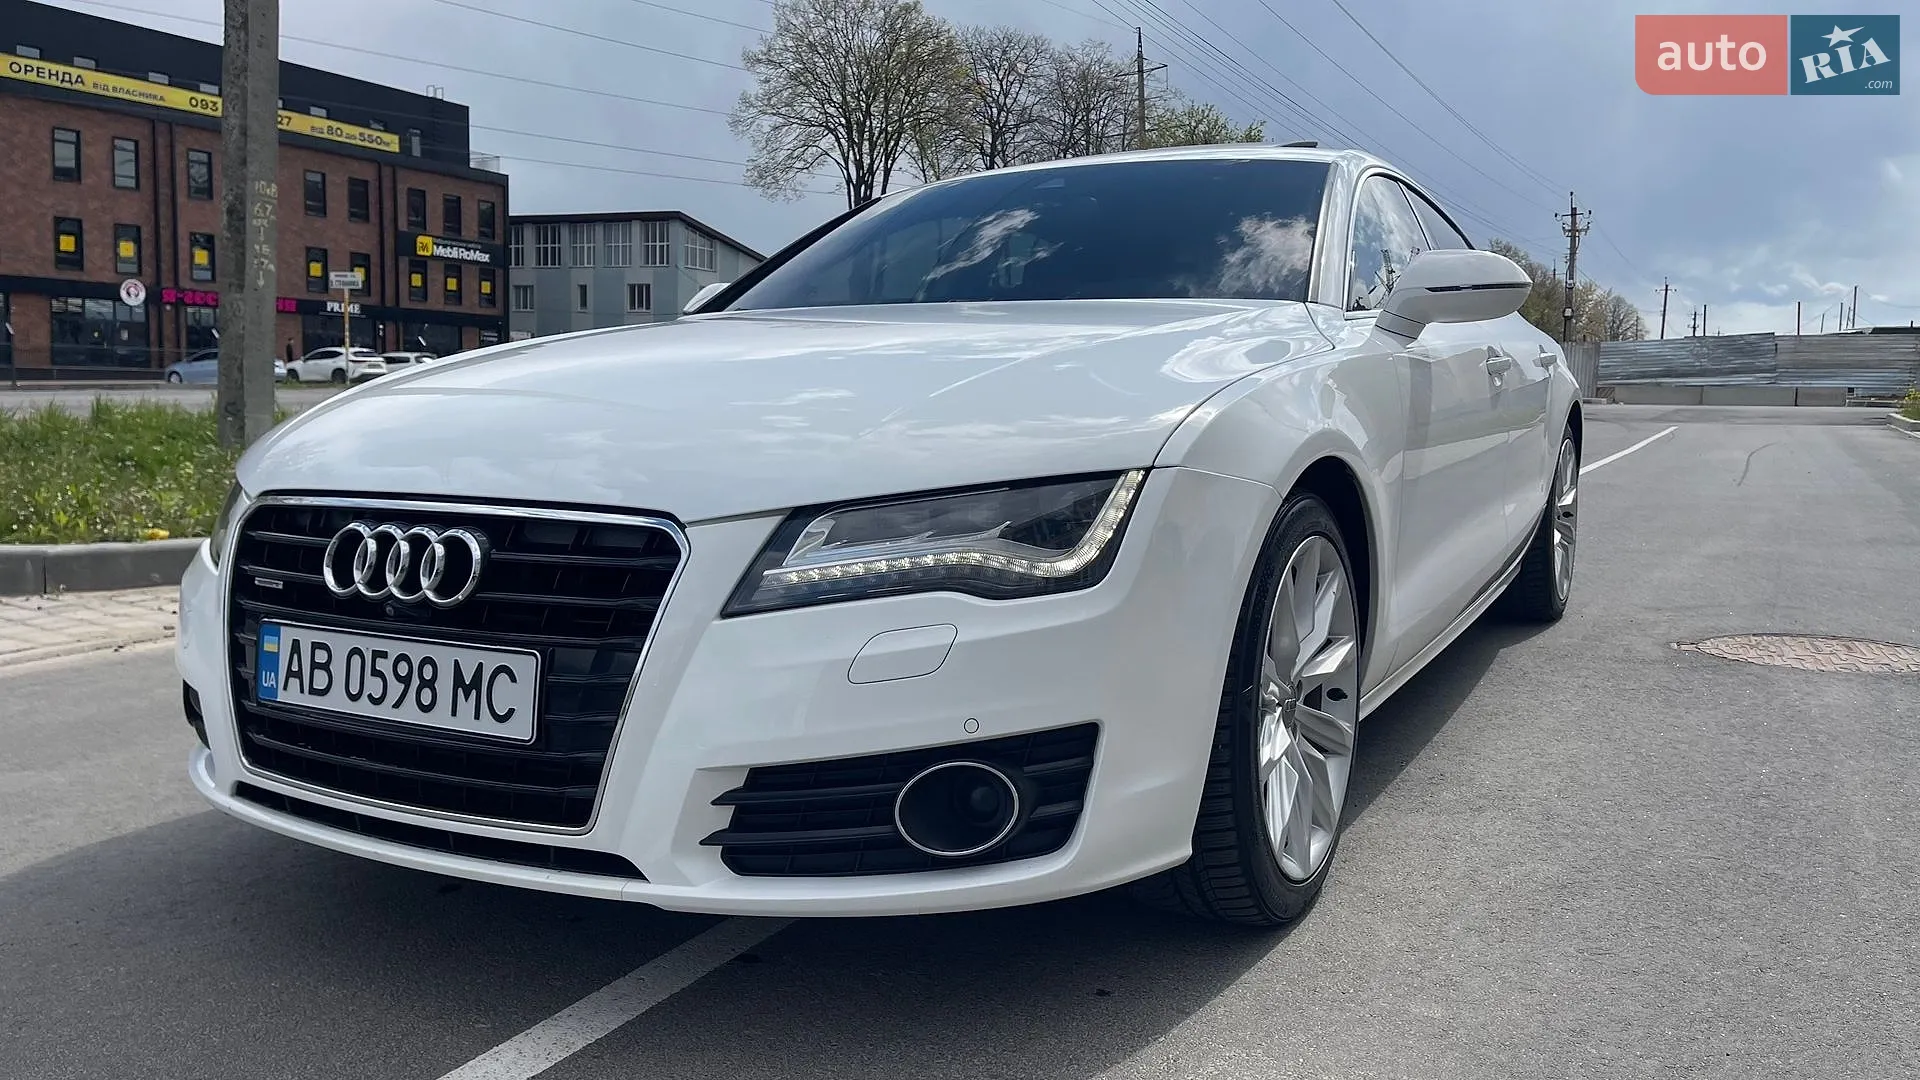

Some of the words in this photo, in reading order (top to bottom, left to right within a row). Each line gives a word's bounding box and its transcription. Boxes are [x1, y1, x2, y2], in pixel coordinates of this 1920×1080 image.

[9, 61, 85, 86] ОРЕНДА
[189, 96, 219, 112] 093
[326, 125, 343, 137] 80
[262, 670, 277, 689] UA
[282, 638, 334, 697] AB
[344, 646, 439, 713] 0598
[451, 658, 518, 724] MC
